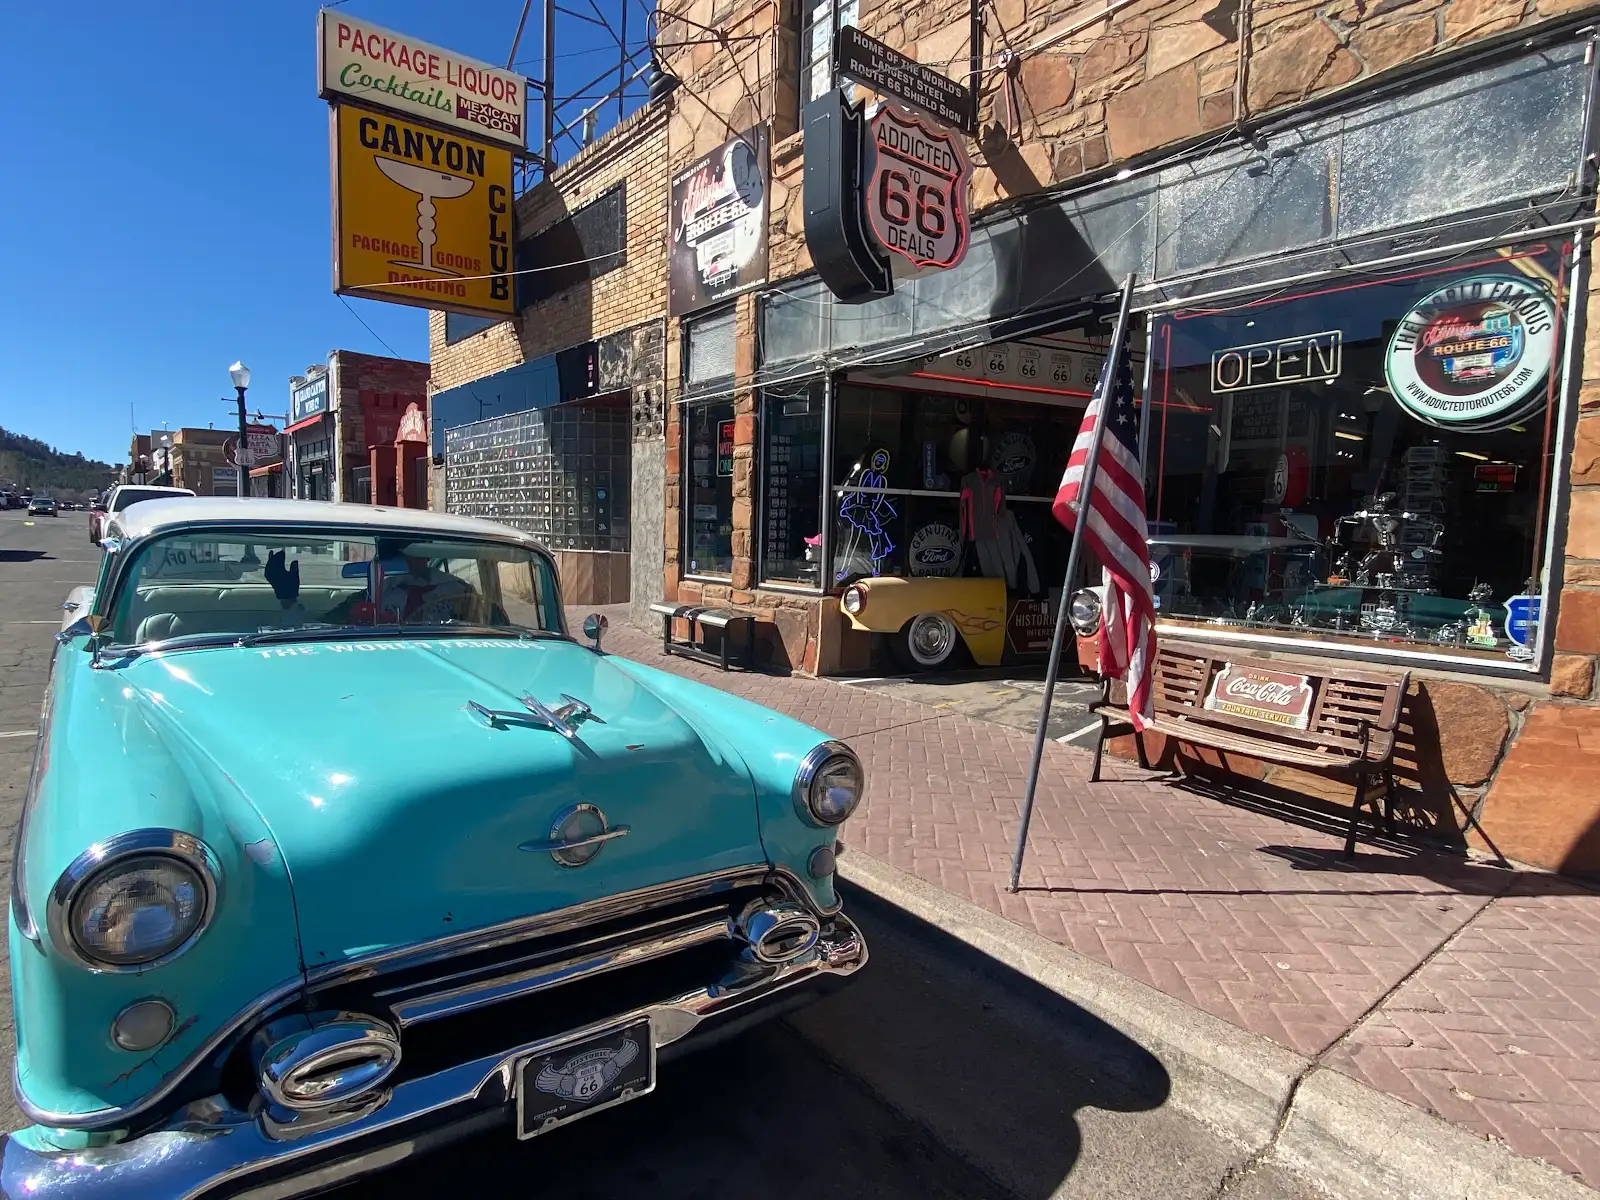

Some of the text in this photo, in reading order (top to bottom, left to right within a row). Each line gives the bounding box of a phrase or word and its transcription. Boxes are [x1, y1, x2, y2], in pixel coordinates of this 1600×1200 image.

[338, 23, 517, 106] PACKAGE LIQUOR
[853, 32, 962, 98] HOME OF THE WORLD'S
[340, 63, 452, 113] Cocktails
[871, 55, 946, 102] LARGEST STEEL
[850, 58, 961, 124] ROUTE 66 SHIELD SIGN
[460, 98, 519, 125] MEXICAN
[467, 112, 514, 134] FOOD
[359, 118, 486, 177] CANYON
[877, 123, 952, 172] ADDICTED
[908, 167, 921, 184] TO
[879, 169, 947, 239] 66
[352, 234, 481, 272] PACKAGE GOODS
[488, 184, 509, 300] CLUB
[888, 226, 935, 259] DEALS
[388, 271, 466, 297] DANCING
[1394, 321, 1420, 353] THE
[1490, 282, 1551, 336] FAMOUS
[1433, 340, 1485, 356] ROUTE
[1489, 337, 1508, 348] 66
[956, 355, 972, 368] 66
[989, 357, 1005, 372] 66
[1022, 362, 1036, 376] 66
[1217, 335, 1335, 388] OPEN
[1053, 368, 1068, 382] 66
[1084, 372, 1098, 385] 66
[1406, 367, 1534, 412] WWW.ADDICTEDTOROUTE66.COM
[912, 525, 959, 549] GENUINE
[922, 548, 948, 562] Ford
[1027, 628, 1056, 637] INTERES
[253, 640, 546, 659] THE WORLD FAMOUS
[1248, 673, 1270, 682] DRINK
[1222, 703, 1291, 724] FOUNTAIN SERVICE
[569, 1051, 608, 1068] HISTORIC
[580, 1065, 598, 1076] ROUTE
[580, 1080, 598, 1095] 66
